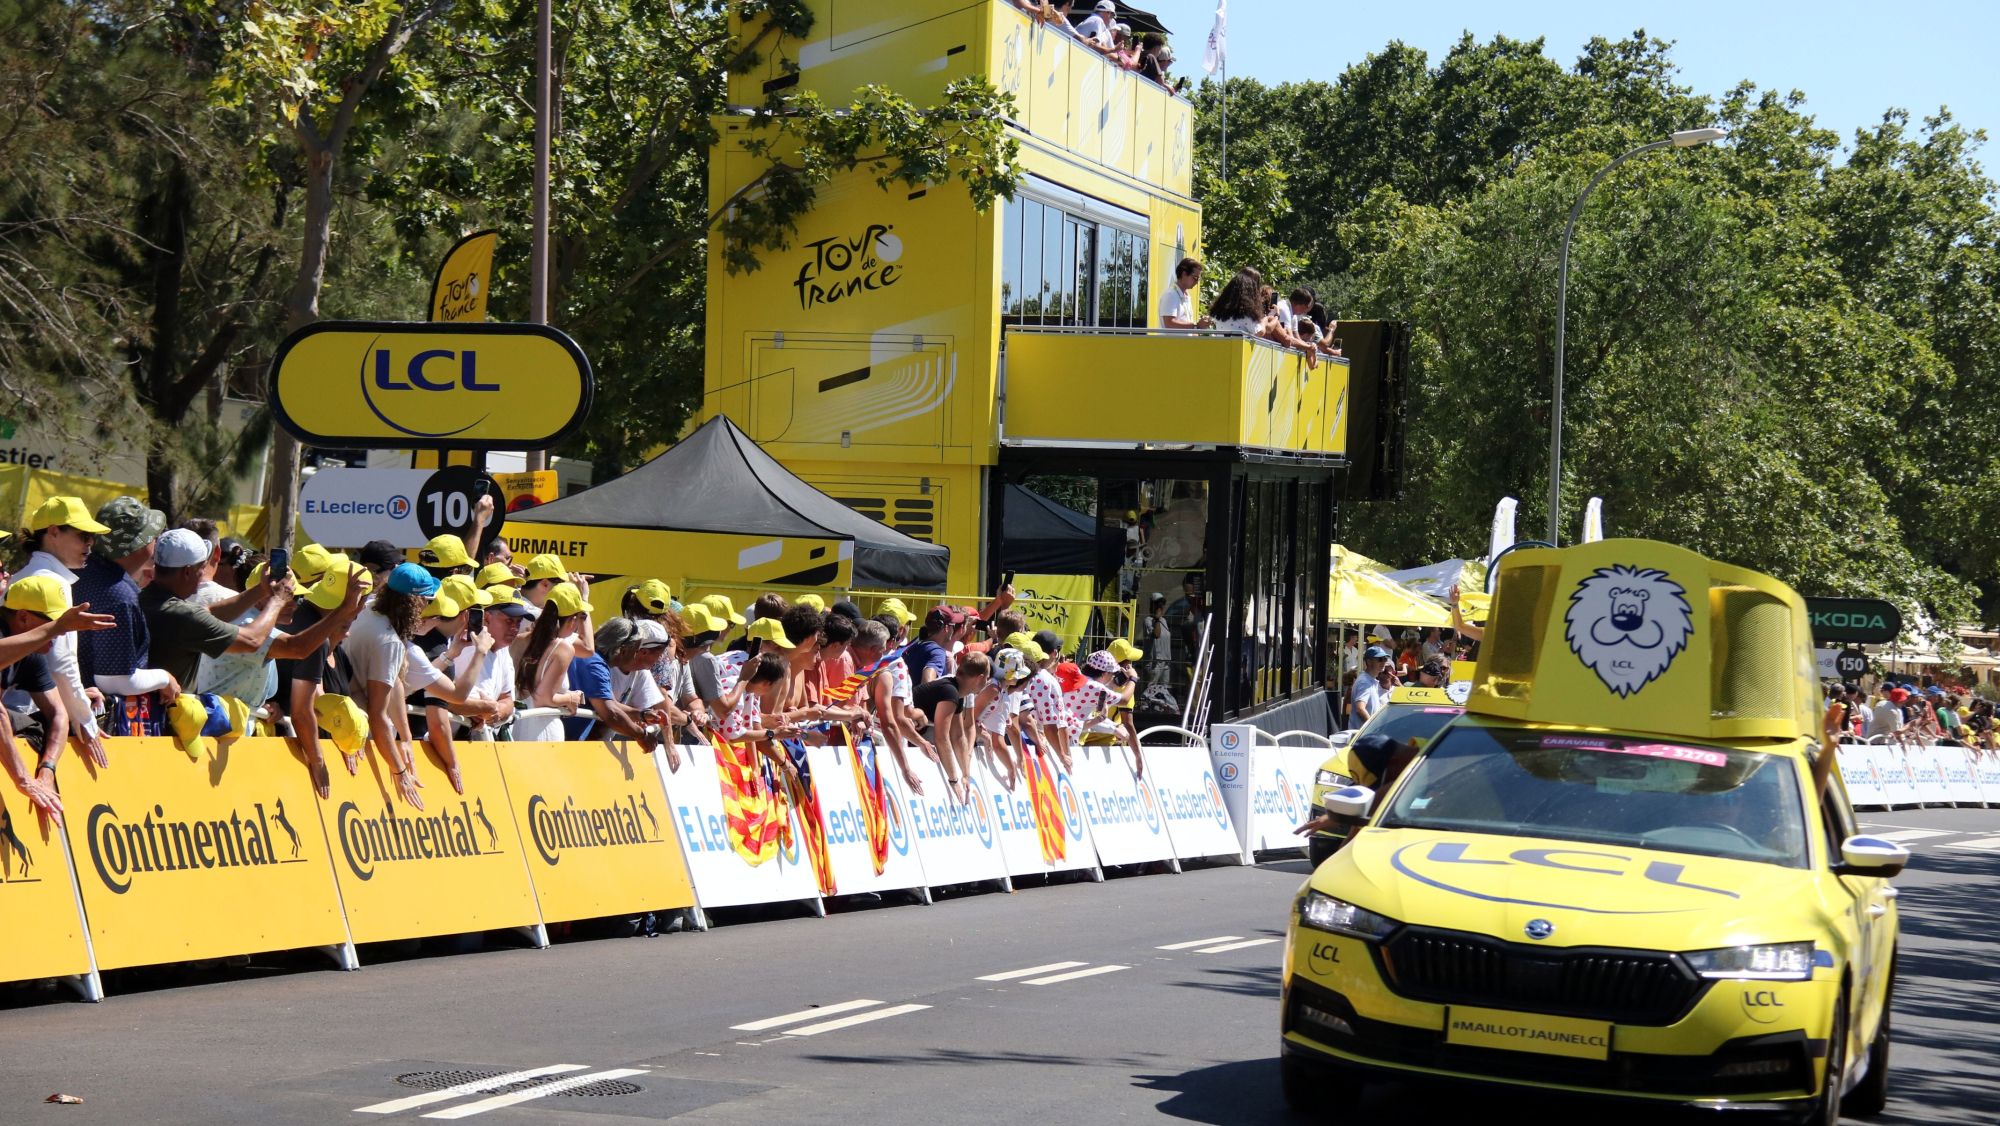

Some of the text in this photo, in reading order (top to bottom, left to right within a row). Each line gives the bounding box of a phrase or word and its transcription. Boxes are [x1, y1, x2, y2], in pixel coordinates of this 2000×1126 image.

[862, 255, 877, 270] de
[375, 350, 500, 391] LCL
[306, 500, 384, 514] E.Leclerc
[427, 491, 493, 528] 10
[1613, 660, 1635, 670] LCL
[1840, 657, 1864, 671] 150
[1543, 738, 1605, 747] CARAVANE
[910, 798, 974, 839] E.Leclerc
[1083, 790, 1142, 825] E.Leclerc
[1159, 789, 1212, 820] E.Leclerc
[338, 800, 481, 881] Continental
[528, 793, 647, 866] Continental
[87, 801, 278, 894] Continental
[1427, 842, 1741, 899] LCL
[1313, 942, 1340, 963] LCL
[1744, 991, 1784, 1007] LCL
